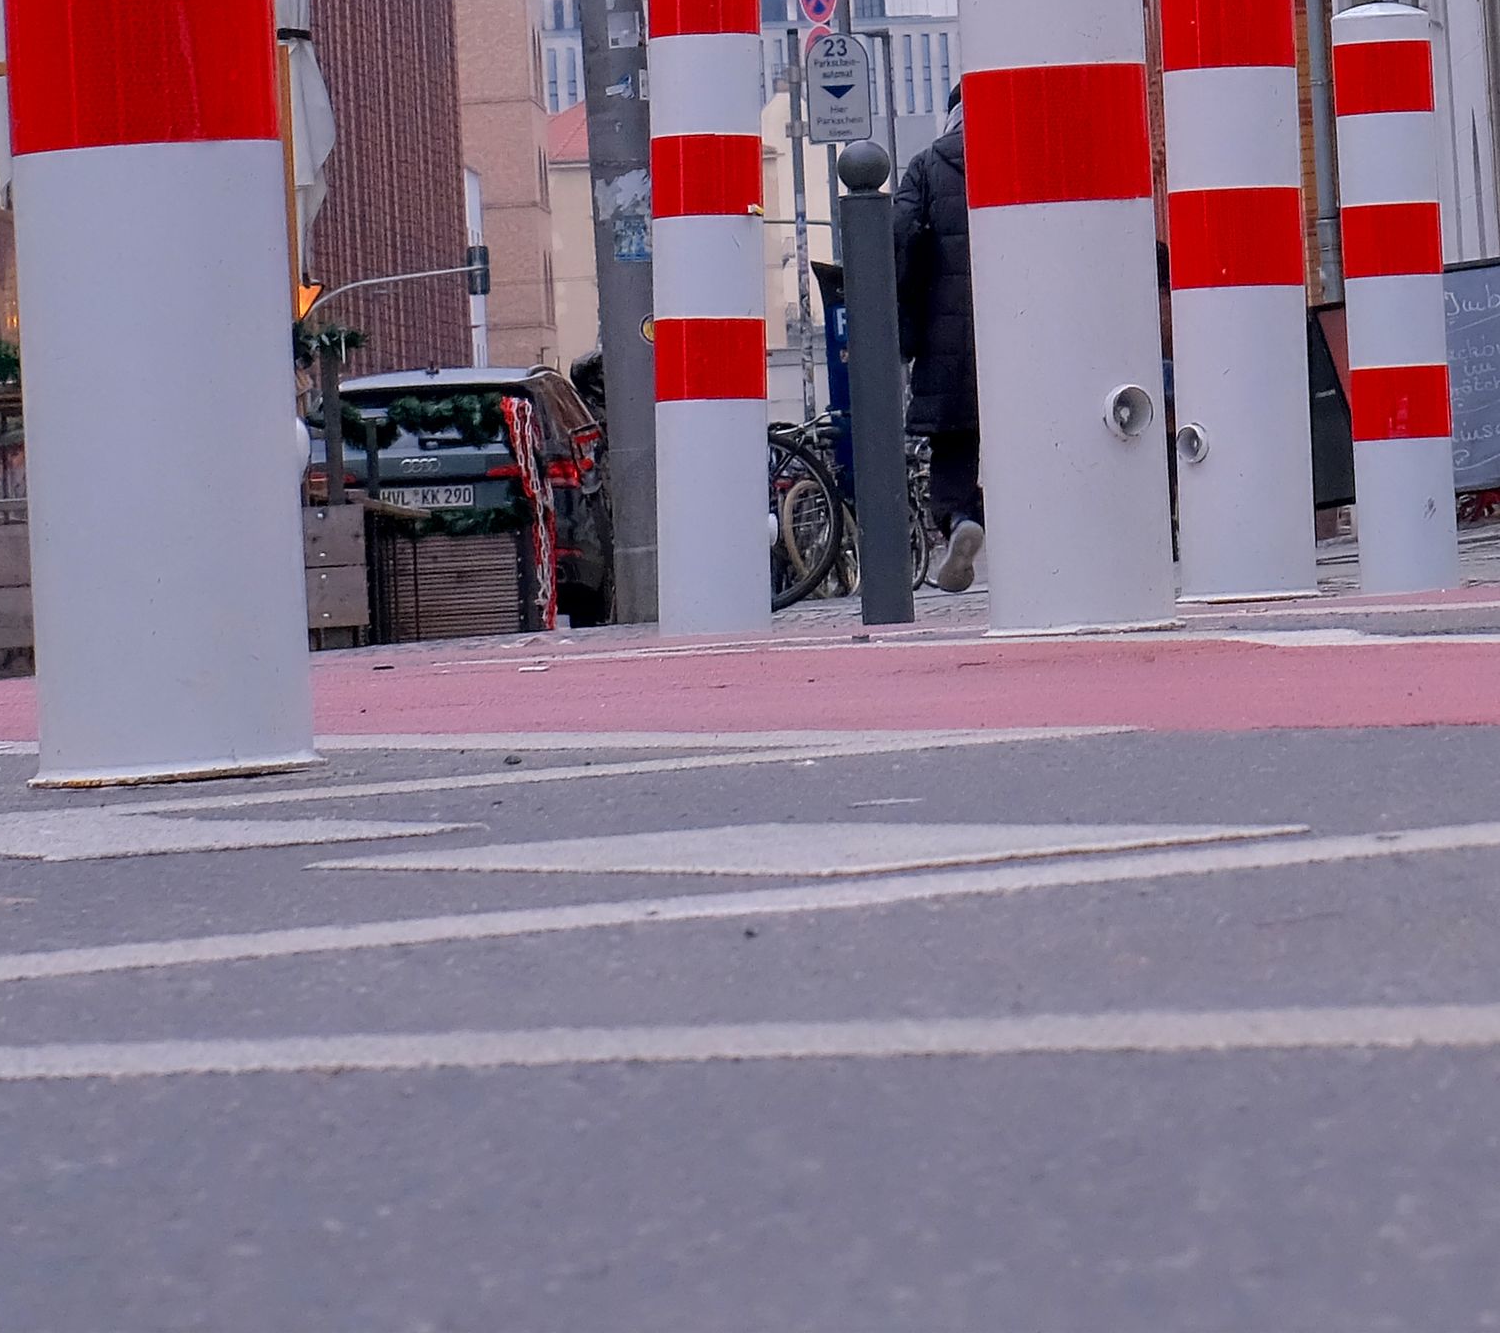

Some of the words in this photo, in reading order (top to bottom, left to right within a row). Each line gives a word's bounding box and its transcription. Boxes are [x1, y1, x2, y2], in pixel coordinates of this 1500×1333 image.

[823, 38, 848, 57] 23
[830, 105, 848, 114] Hier
[382, 490, 410, 506] HVL
[421, 488, 440, 505] KK
[444, 487, 472, 504] 290
